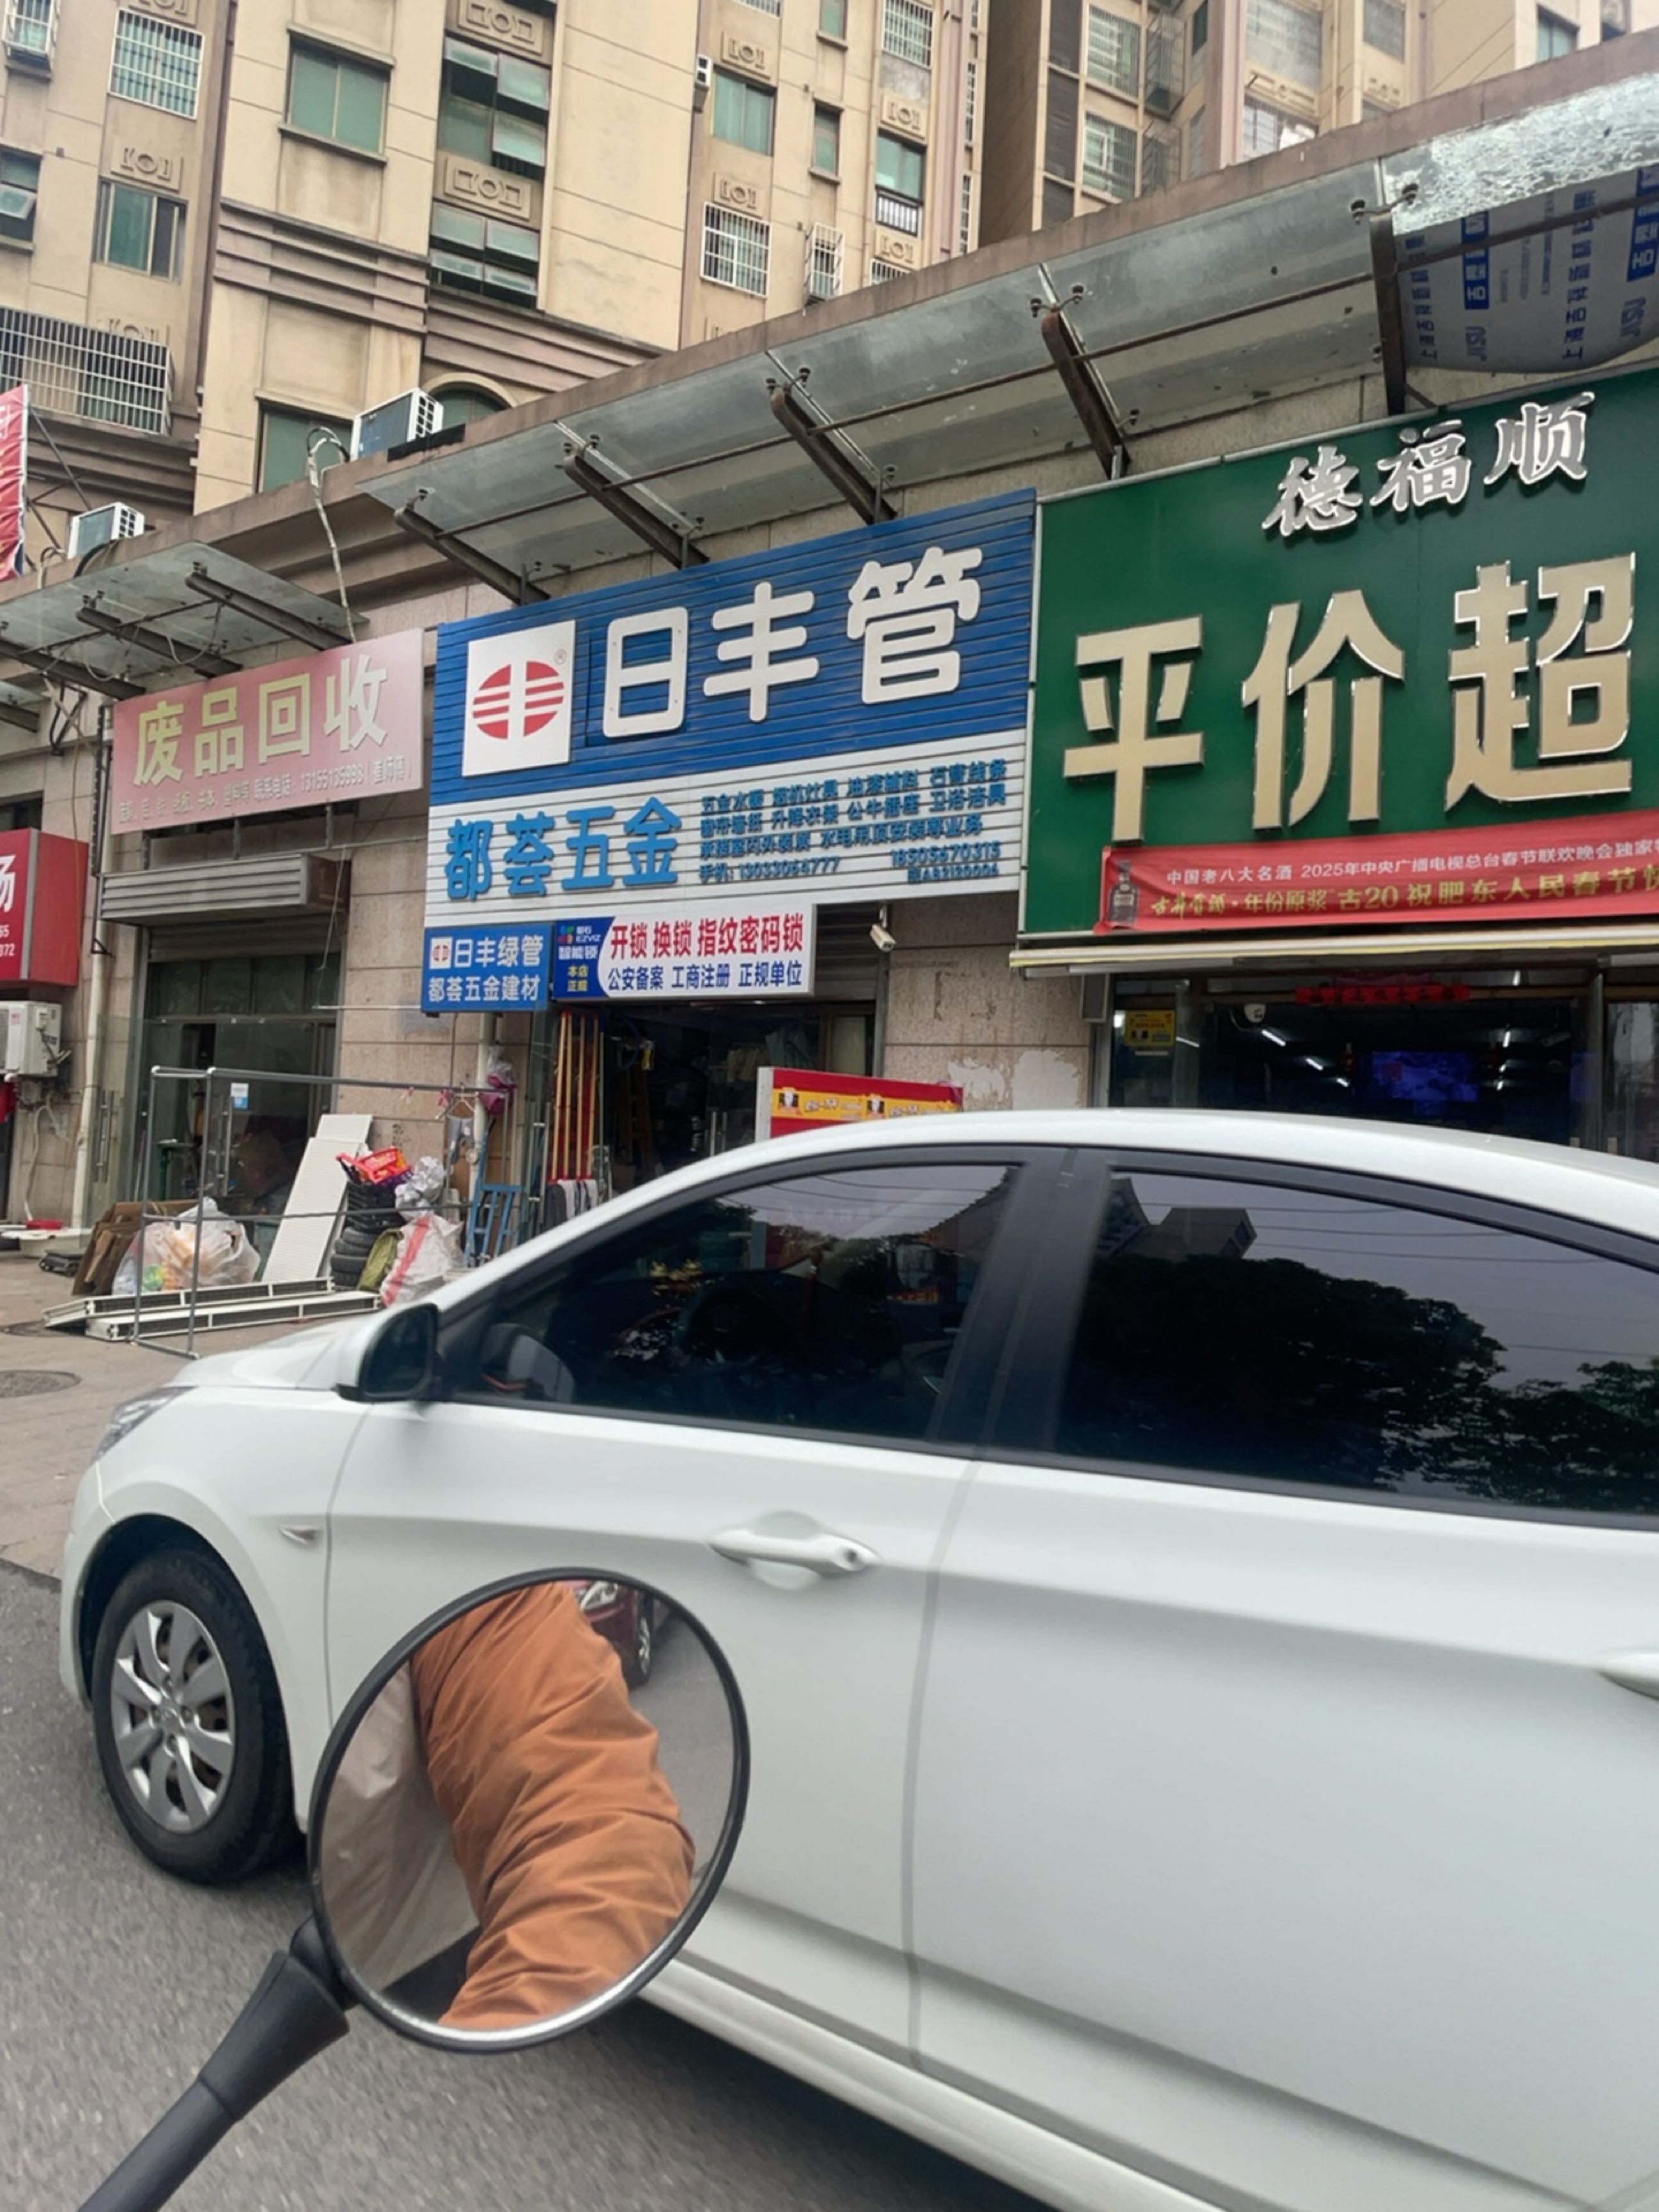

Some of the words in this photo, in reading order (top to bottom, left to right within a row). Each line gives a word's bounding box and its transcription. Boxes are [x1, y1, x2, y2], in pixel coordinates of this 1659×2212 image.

[1263, 391, 1596, 536] 德福顺
[602, 547, 982, 737] 日丰管
[134, 654, 388, 787] 废品回收
[1063, 552, 1635, 844] 平价超
[445, 796, 682, 902] 都荟五金
[1167, 864, 1292, 886] 中国老八大名酒
[1301, 838, 1659, 878] 2025年中央广播电视总台春节联欢晚会独家
[1339, 885, 1399, 910] 古20
[454, 936, 543, 968] 日丰绿管
[611, 922, 648, 959] 开锁
[653, 920, 692, 958] 换锁
[697, 913, 804, 957] 指纹密码锁
[429, 974, 540, 1002] 都荟五金建材
[608, 965, 664, 991] 公安备案
[672, 963, 730, 989] 工商注册
[738, 960, 801, 987] 正规单位
